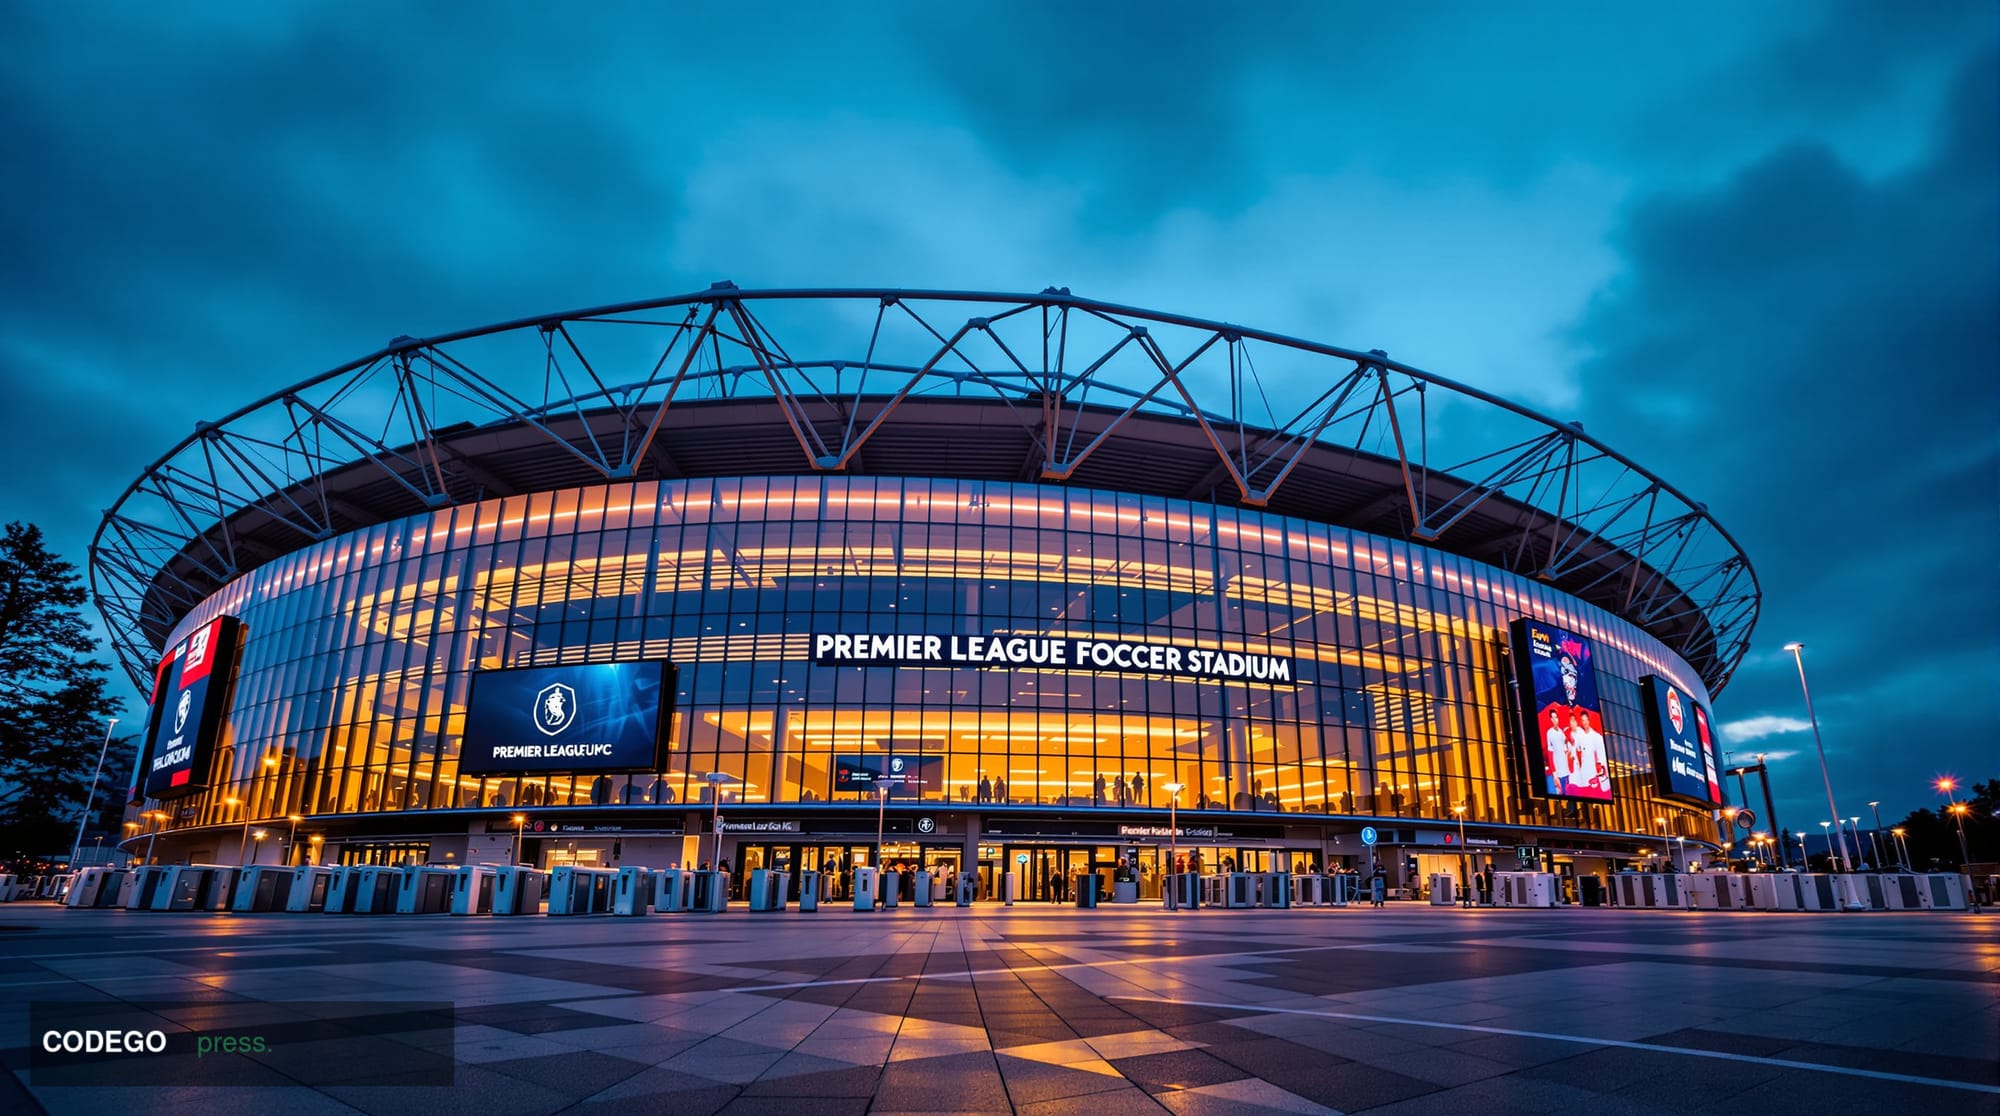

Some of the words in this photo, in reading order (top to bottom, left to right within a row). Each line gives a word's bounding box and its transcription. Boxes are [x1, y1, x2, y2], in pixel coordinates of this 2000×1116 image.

[815, 634, 942, 660] PREMIER
[950, 636, 1067, 665] LEAGUE
[1076, 641, 1182, 671] FOCCER
[1187, 650, 1291, 682] STADIUM
[493, 746, 542, 758] PREMIER
